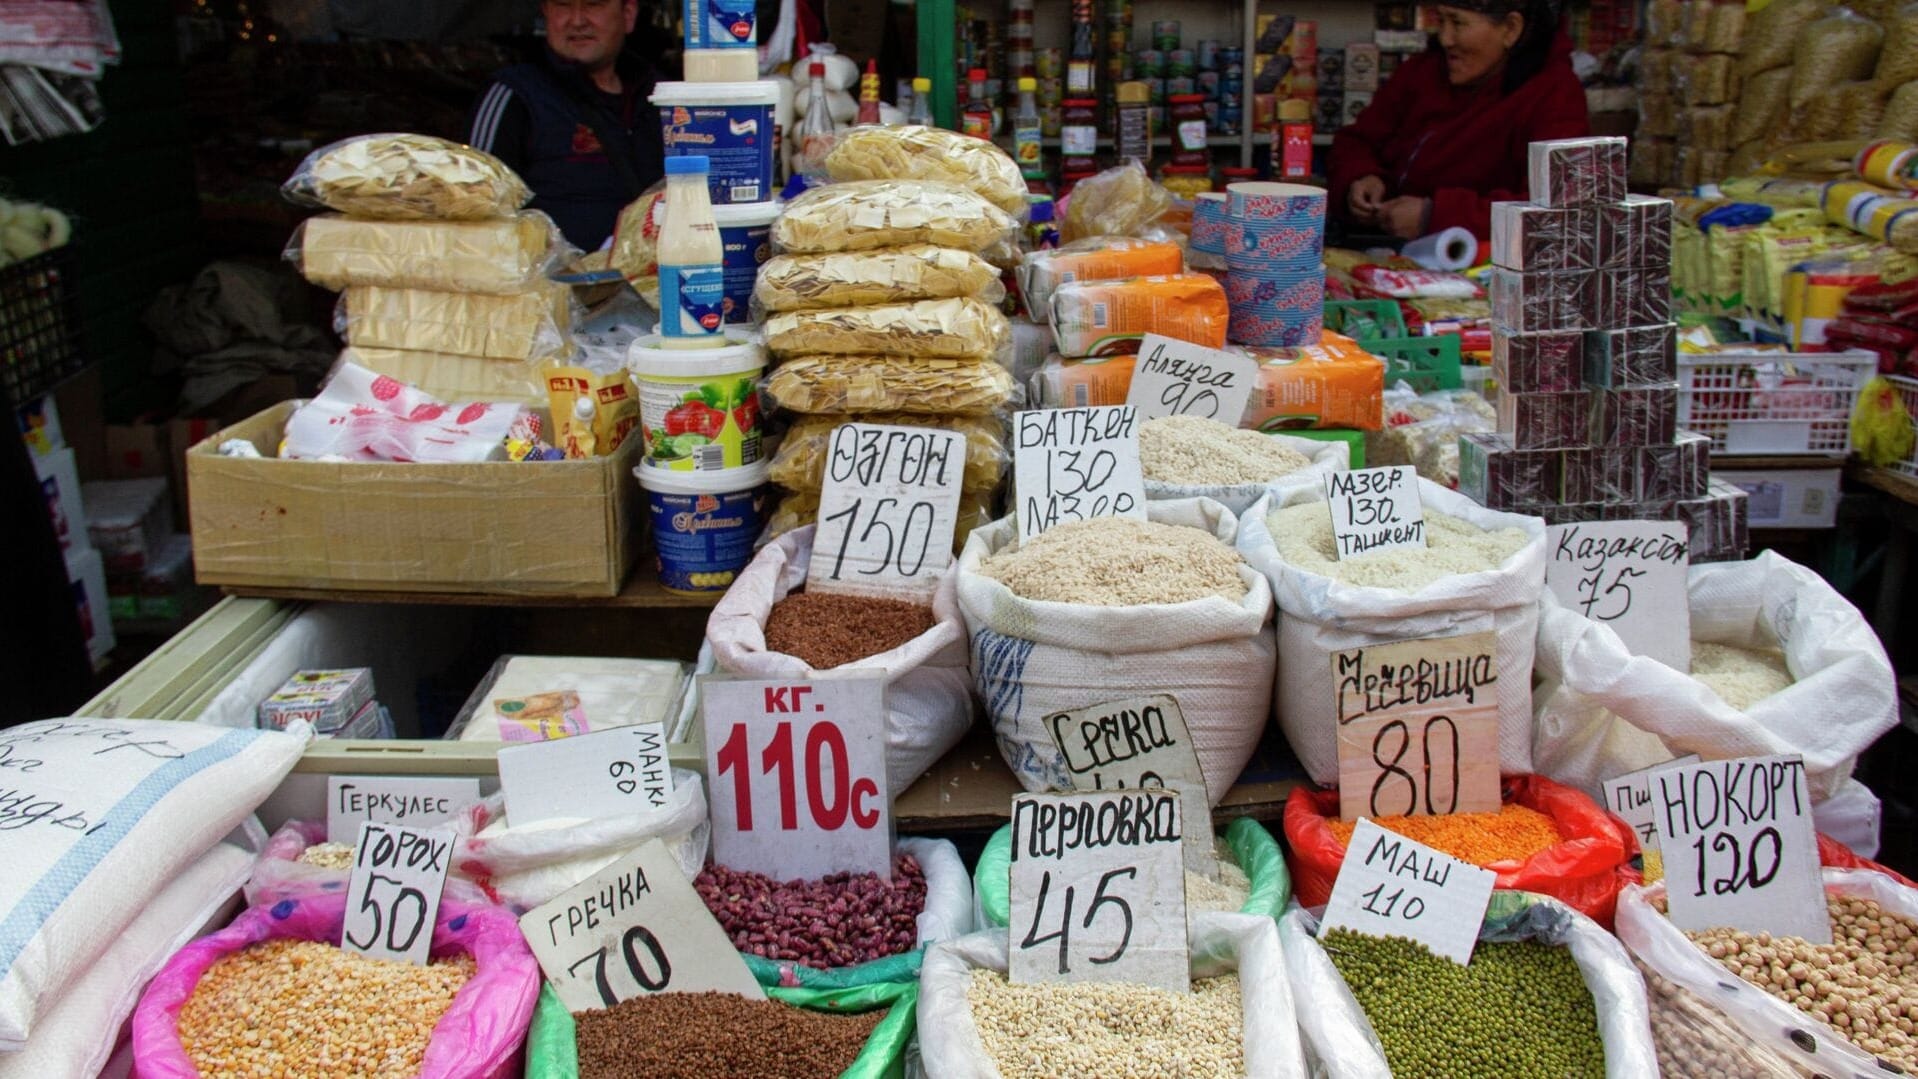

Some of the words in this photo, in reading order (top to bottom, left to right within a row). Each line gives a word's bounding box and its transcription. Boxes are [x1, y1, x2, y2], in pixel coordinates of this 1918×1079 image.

[1046, 449, 1117, 498] 130
[825, 498, 935, 580] 150
[1577, 567, 1647, 620] 75
[609, 761, 637, 794] 60
[1370, 715, 1459, 817] 80
[1660, 760, 1806, 838] НОКОРТ
[358, 825, 447, 872] ГОРОХ
[1365, 834, 1452, 887] МАШ
[1692, 826, 1783, 897] 120
[346, 872, 428, 952] 50
[548, 866, 651, 947] ГРЕЧКА
[1020, 866, 1137, 974] 45
[1362, 883, 1425, 920] 110
[567, 925, 672, 1009] 70
